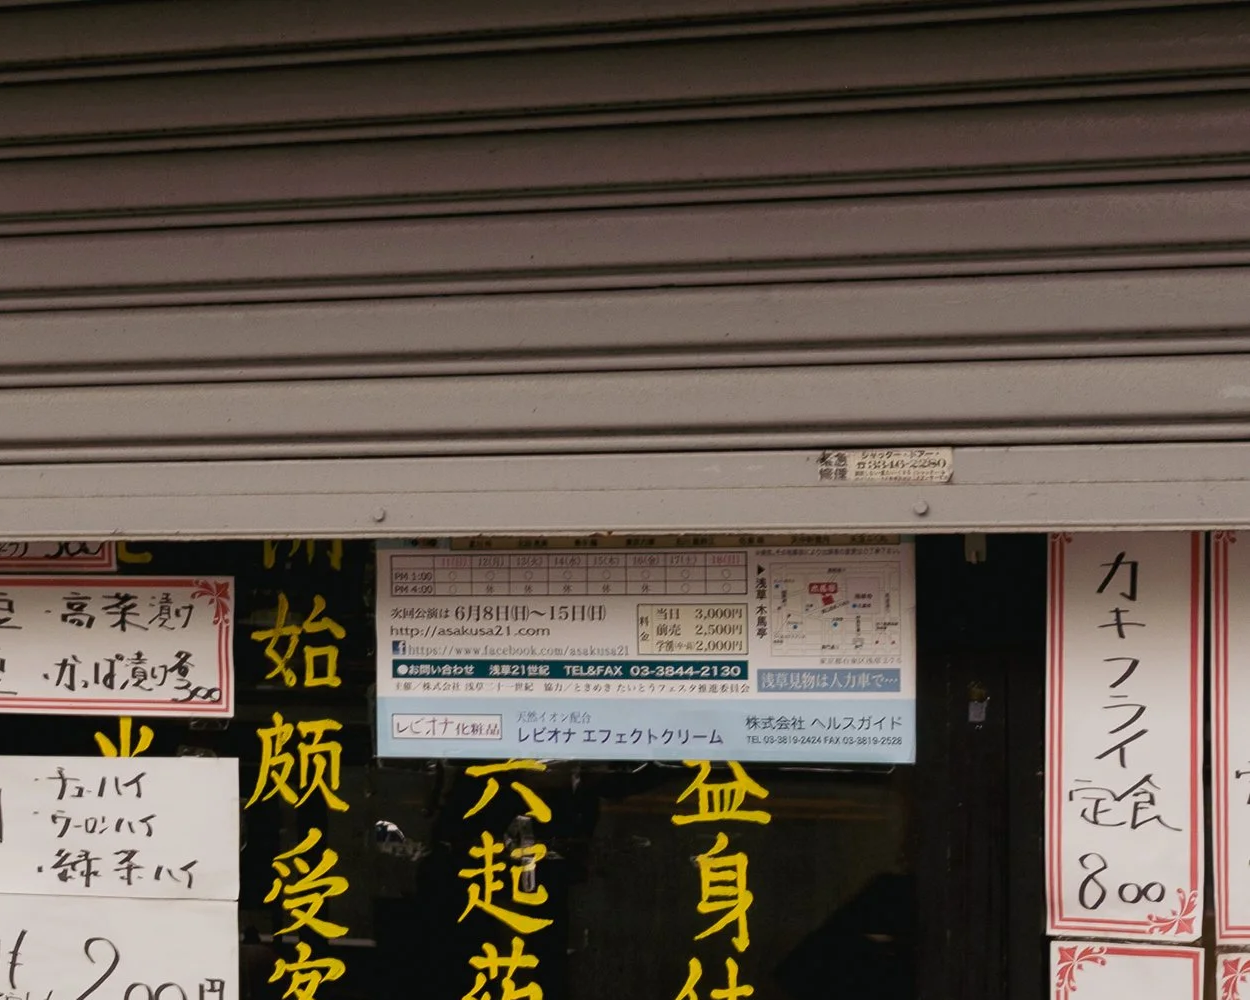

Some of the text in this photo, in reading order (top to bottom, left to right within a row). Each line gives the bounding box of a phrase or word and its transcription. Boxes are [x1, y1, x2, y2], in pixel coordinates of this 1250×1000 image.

[394, 572, 433, 581] PM 1:00
[394, 585, 409, 593] PM
[410, 585, 433, 594] 4:00
[656, 608, 743, 620] 当日 3,000円
[390, 625, 551, 638] http://asakusa21.com
[656, 623, 743, 636] 前売 2,500円
[695, 640, 743, 652] 2,000円
[489, 664, 550, 676] 浅草21世紀
[563, 665, 623, 677] TEL&FAX
[629, 665, 741, 677] 03-3844-2130
[746, 715, 903, 731] 株式会社 ヘルスガイド
[518, 727, 724, 744] レビオナ エフェクトクリーム
[747, 736, 762, 744] TEL
[823, 736, 841, 745] FAX
[1077, 852, 1166, 911] 800
